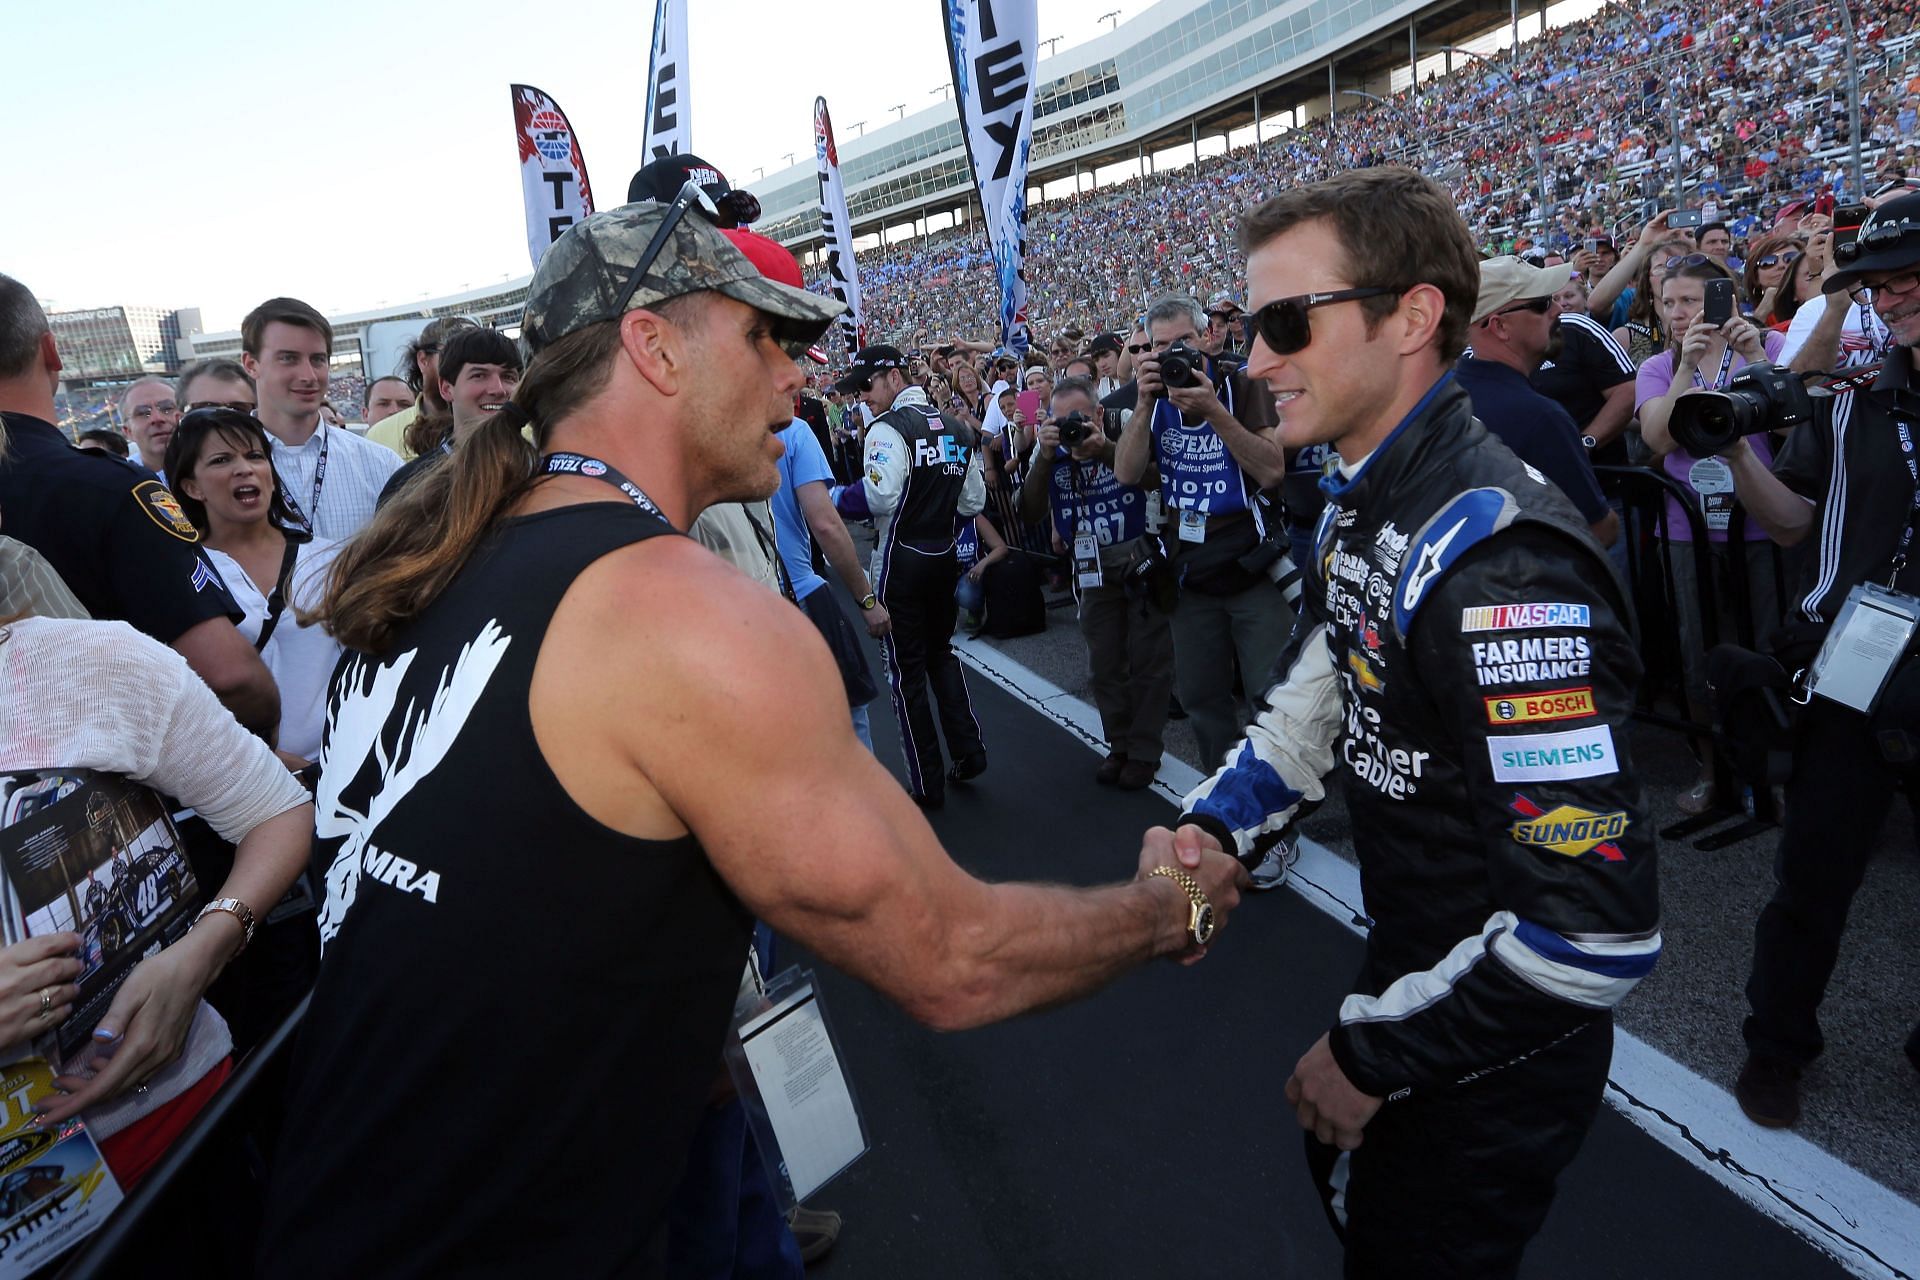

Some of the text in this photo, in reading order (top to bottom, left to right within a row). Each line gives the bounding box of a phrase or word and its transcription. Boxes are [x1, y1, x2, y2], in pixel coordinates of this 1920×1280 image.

[549, 459, 580, 471] TEXAS
[915, 435, 968, 468] FedEx
[1061, 492, 1135, 519] PHOTO
[957, 543, 975, 553] XAS
[1505, 606, 1587, 627] NASCAR
[1472, 637, 1590, 666] FARMERS
[1476, 659, 1590, 686] INSURANCE
[1526, 695, 1587, 716] BOSCH
[1347, 702, 1430, 777] Wrner
[1502, 743, 1604, 768] SIEMENS
[1518, 815, 1623, 842] SUNOCO
[362, 844, 441, 903] MRA
[137, 872, 158, 917] 48
[0, 1144, 28, 1167] print
